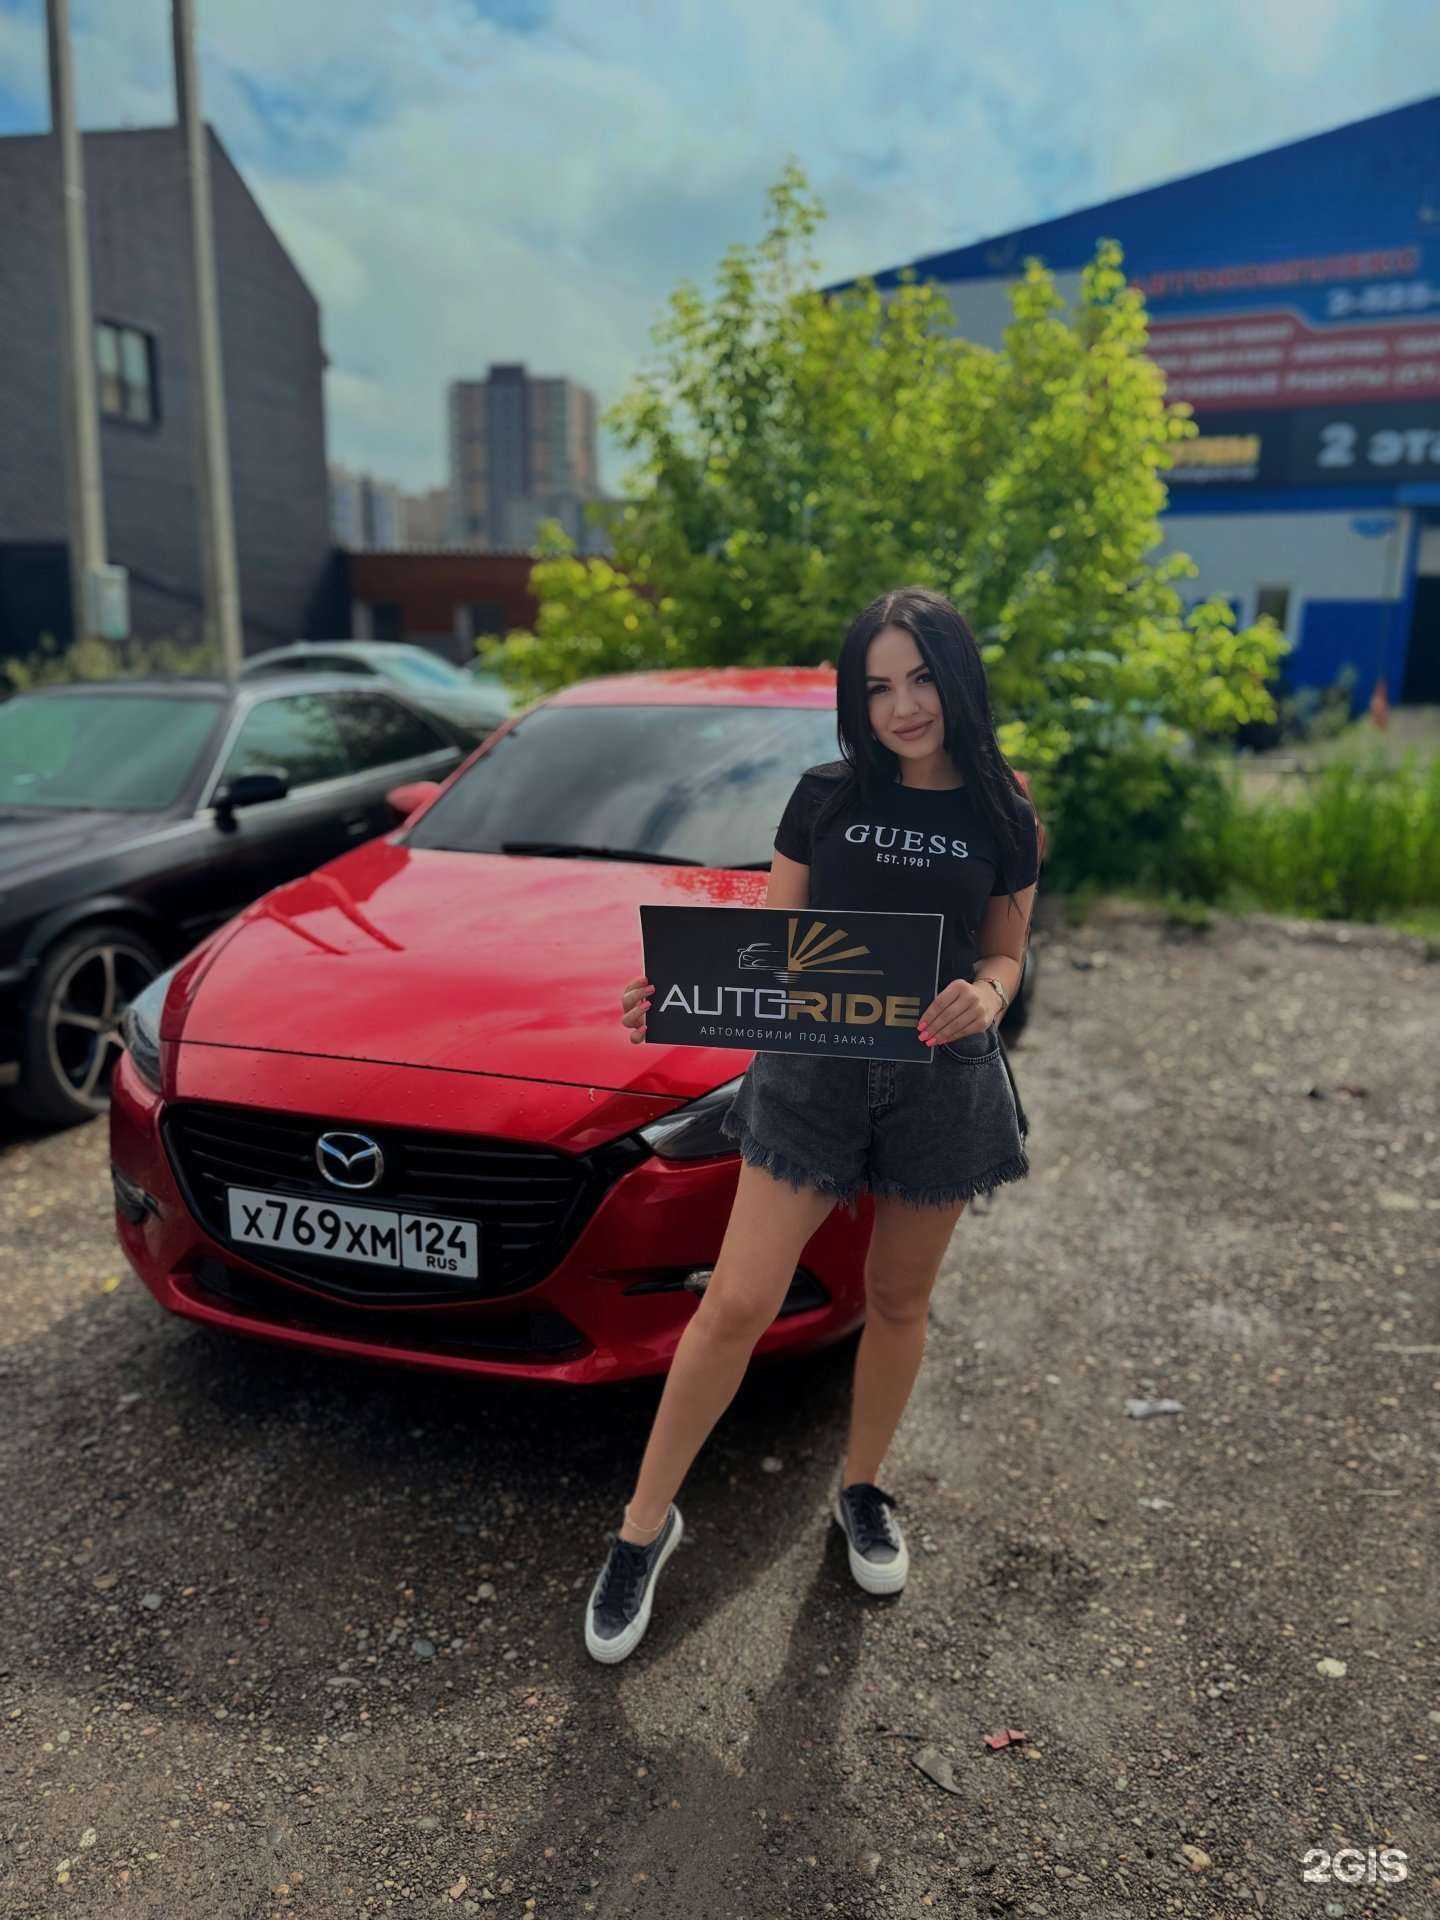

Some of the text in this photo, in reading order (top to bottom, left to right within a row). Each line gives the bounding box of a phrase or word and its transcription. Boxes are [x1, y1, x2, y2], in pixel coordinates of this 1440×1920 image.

[1317, 423, 1355, 468] 2
[844, 824, 969, 858] GUESS
[700, 1026, 875, 1046] АВТОМОБИЛИ ПОД ЗАКАЗ
[404, 1219, 468, 1259] 124
[426, 1255, 459, 1271] RUS
